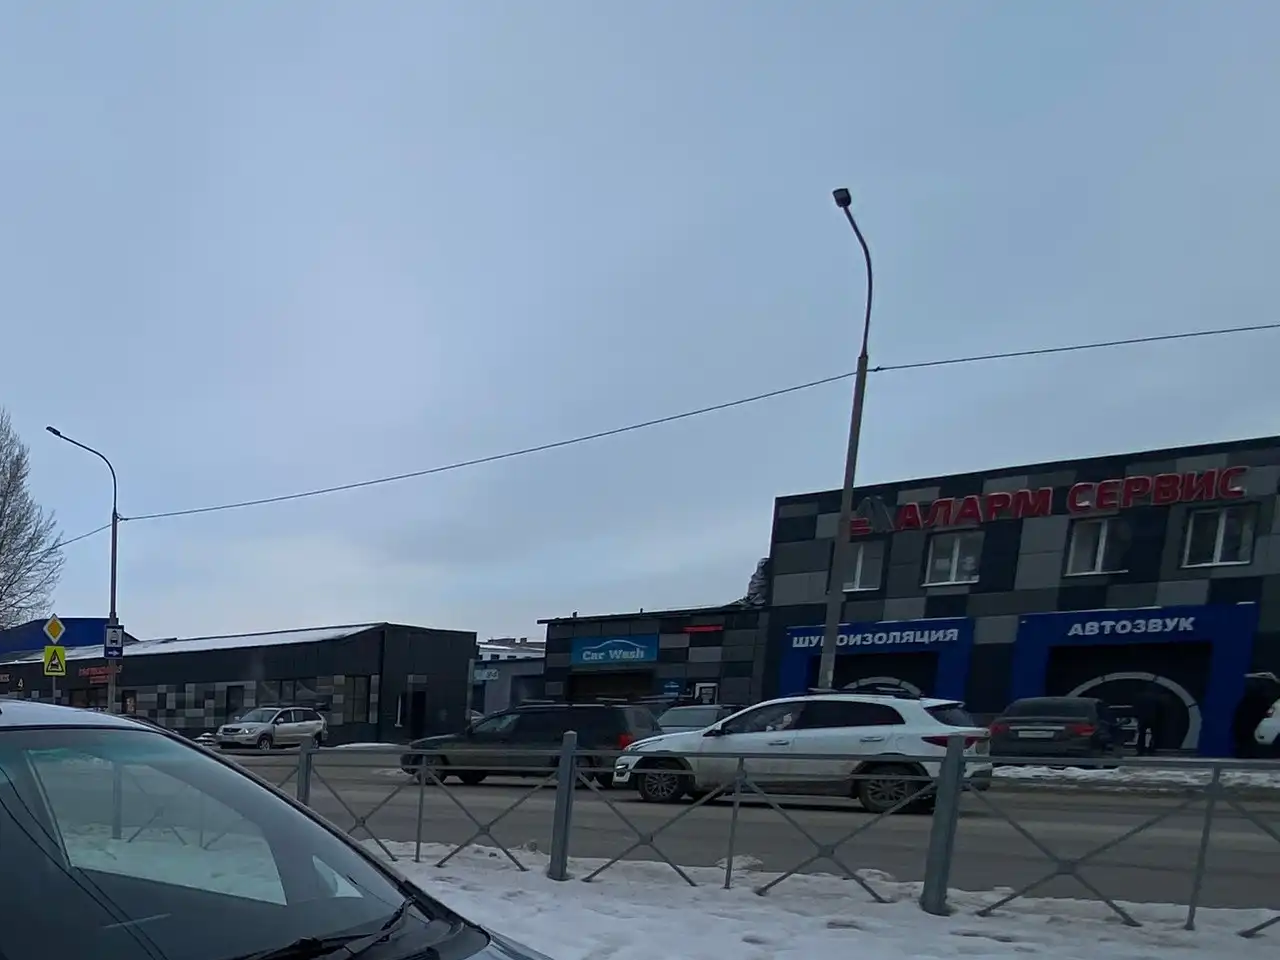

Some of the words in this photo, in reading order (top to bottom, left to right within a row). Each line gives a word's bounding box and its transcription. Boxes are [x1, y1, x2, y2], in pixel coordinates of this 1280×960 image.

[894, 486, 1053, 532] АЛАРМ
[1067, 465, 1251, 515] СЕРВИС
[1067, 616, 1196, 636] АВТОЗВУК
[792, 628, 960, 648] ШУОИЗОЛЯЦИЯ
[582, 650, 605, 661] Car
[609, 648, 645, 660] Wash
